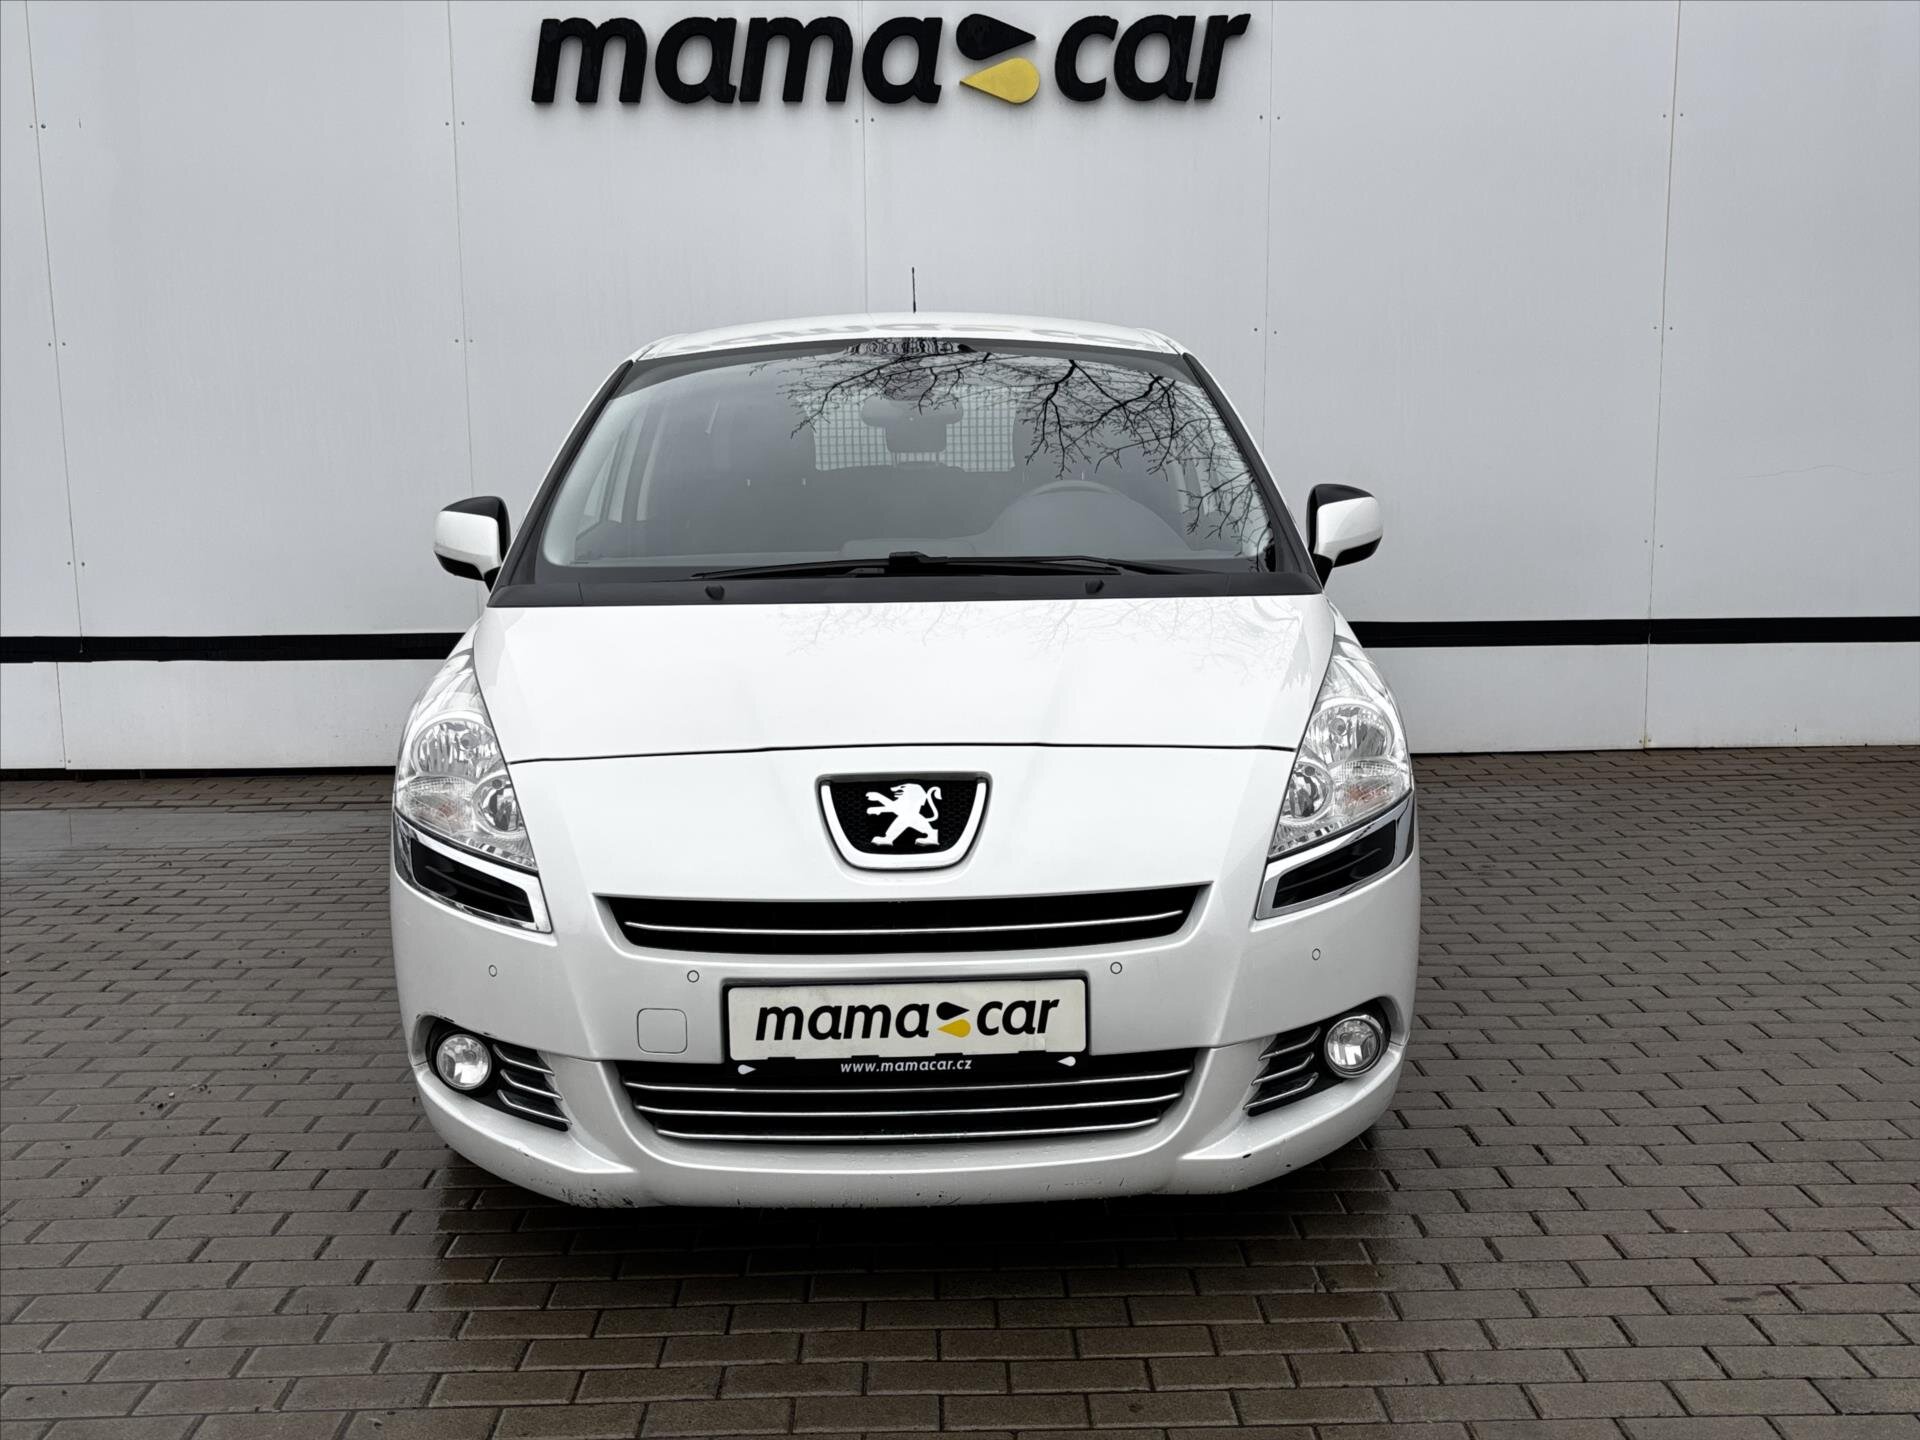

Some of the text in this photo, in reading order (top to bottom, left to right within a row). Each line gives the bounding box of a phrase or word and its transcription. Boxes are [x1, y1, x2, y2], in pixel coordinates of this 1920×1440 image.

[531, 13, 1250, 104] mama car
[755, 998, 1060, 1041] mama car
[840, 1058, 972, 1074] www.mamacar.cz
